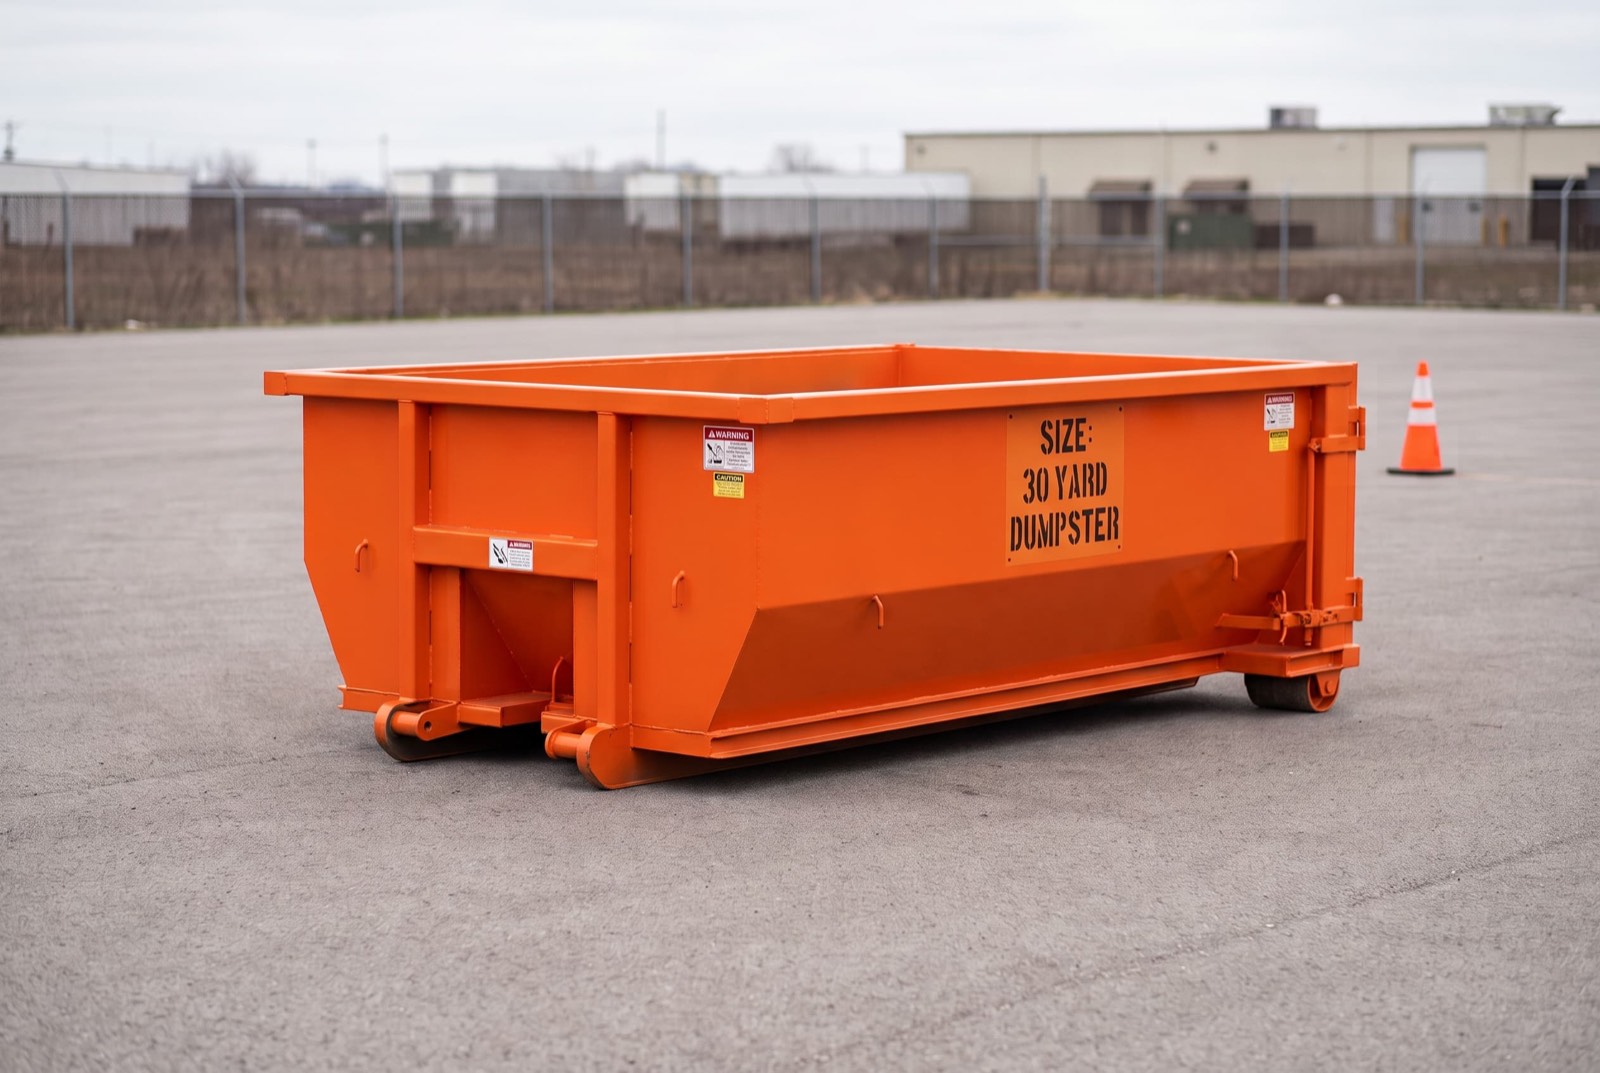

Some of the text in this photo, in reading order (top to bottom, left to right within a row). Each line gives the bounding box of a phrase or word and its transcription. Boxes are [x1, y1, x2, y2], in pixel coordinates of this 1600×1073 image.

[715, 430, 750, 440] WARNING
[1040, 417, 1092, 455] SIZE:
[716, 474, 742, 482] CAUTION
[1023, 461, 1108, 504] 30 YARD
[1010, 506, 1119, 551] DUMPSTER
